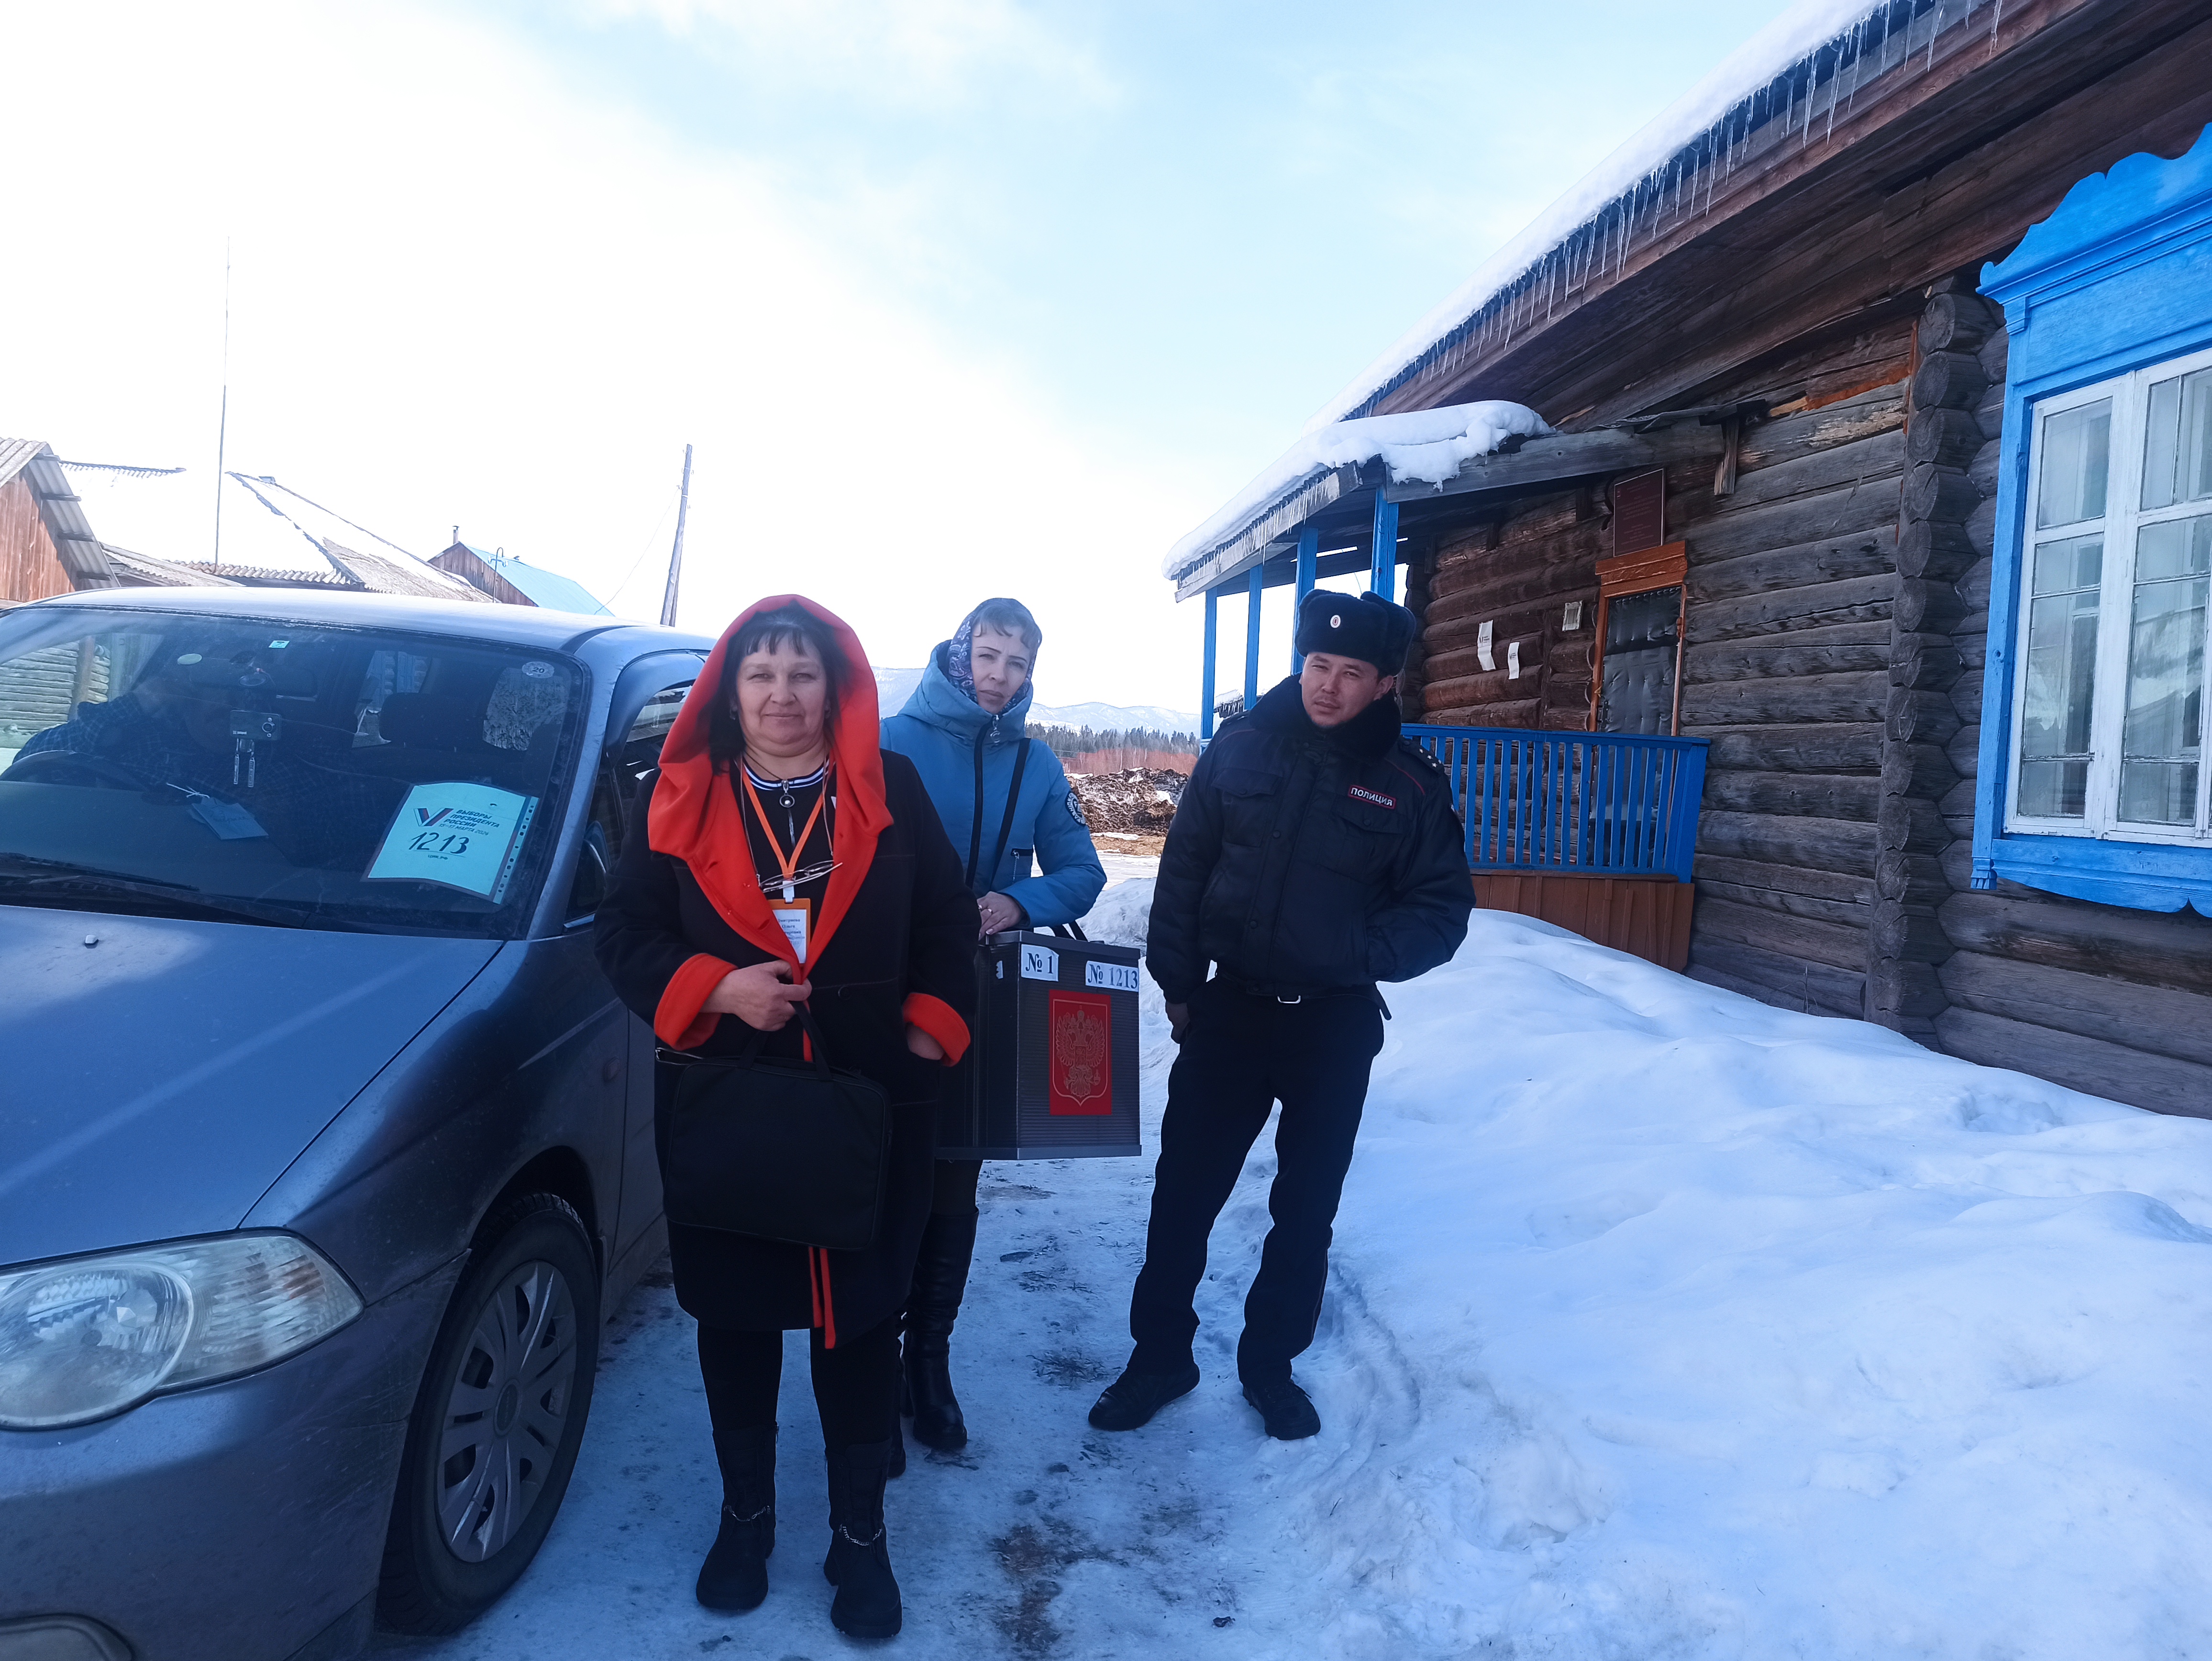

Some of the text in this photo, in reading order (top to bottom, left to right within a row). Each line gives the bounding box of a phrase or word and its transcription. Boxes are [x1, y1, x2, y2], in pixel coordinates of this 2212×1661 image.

[1350, 787, 1393, 806] ПОЛИЦИЯ
[443, 819, 477, 827] РОССИИ
[450, 814, 500, 828] ПРЕЗИДЕНТА
[456, 809, 492, 819] ВЫБОРЫ
[409, 832, 469, 854] 1213
[1026, 952, 1053, 974] № 1
[1088, 964, 1138, 989] № 1213
